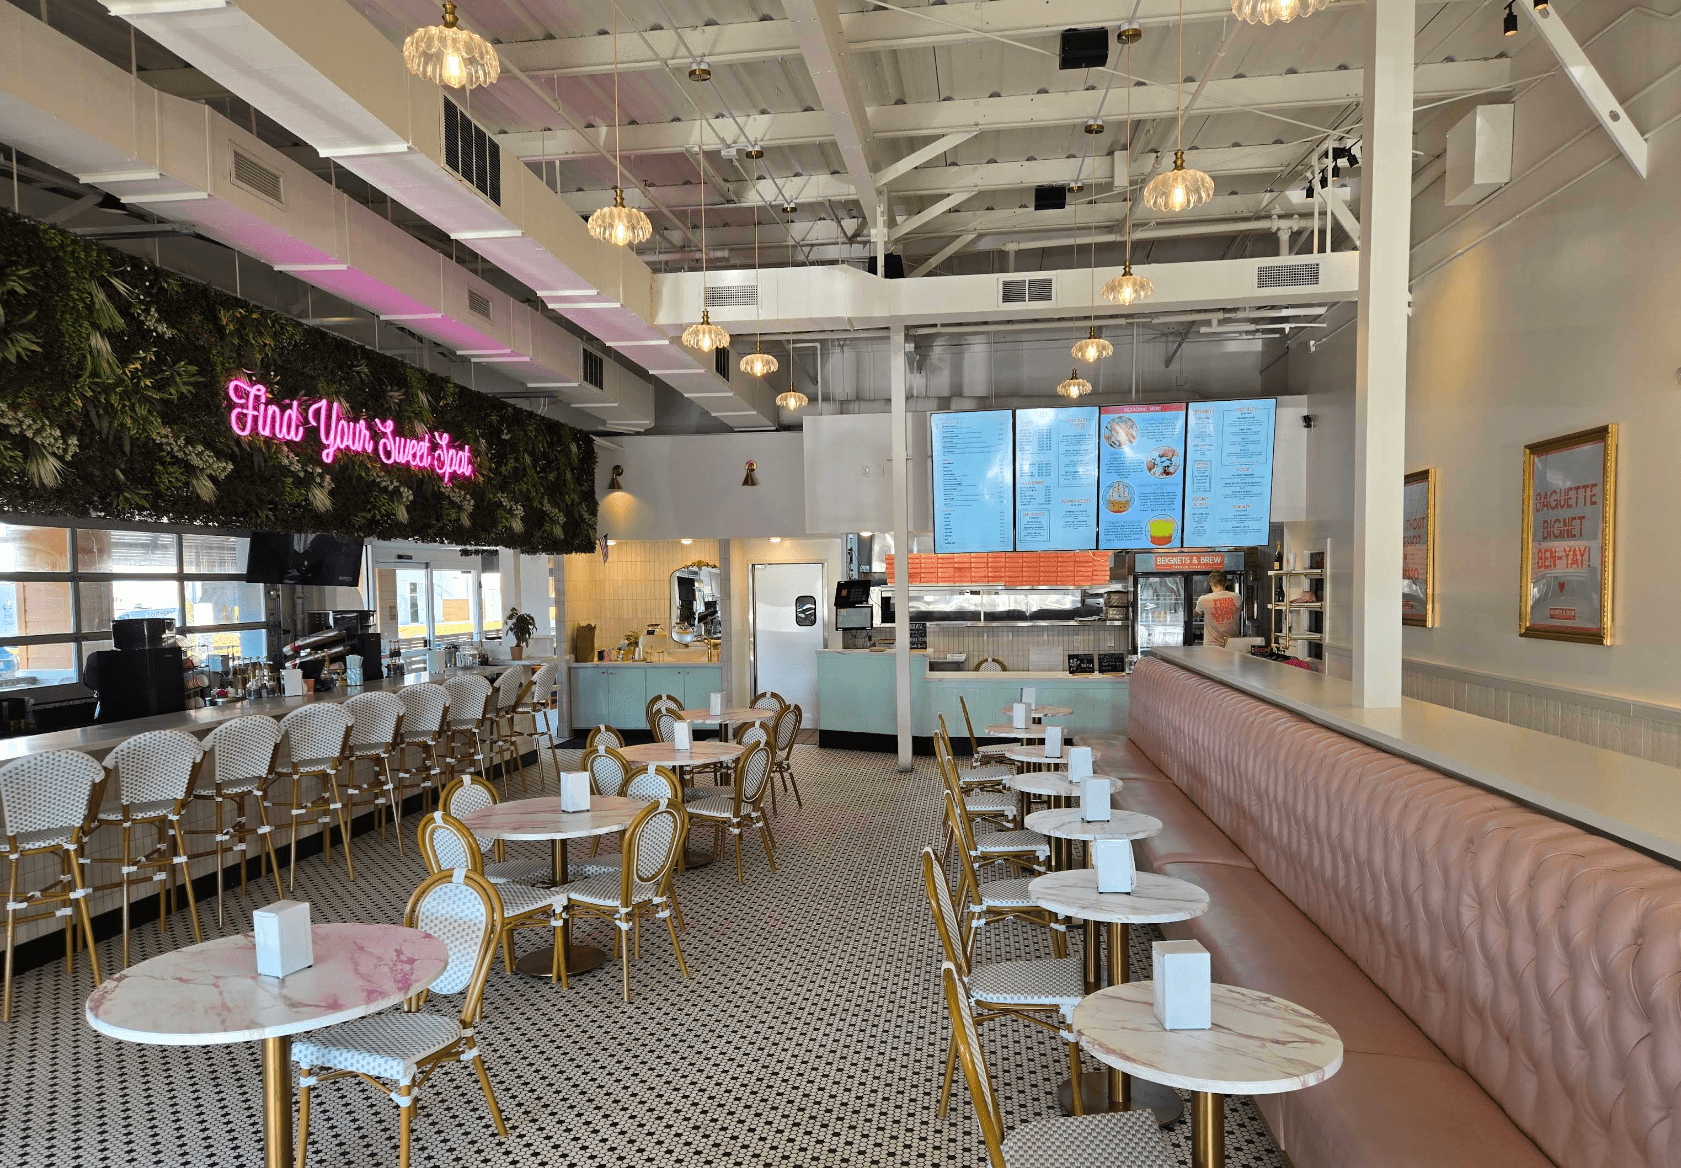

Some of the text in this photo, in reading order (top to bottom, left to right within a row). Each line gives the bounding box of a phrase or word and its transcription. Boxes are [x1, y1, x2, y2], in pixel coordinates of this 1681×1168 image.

[228, 379, 473, 485] Find Your Sweet Spot
[1535, 482, 1598, 513] BAGUETTE
[1542, 515, 1586, 540] BIGNET
[1157, 555, 1222, 565] BEIGNETS & BREW
[1537, 545, 1591, 570] BEN-YAY!
